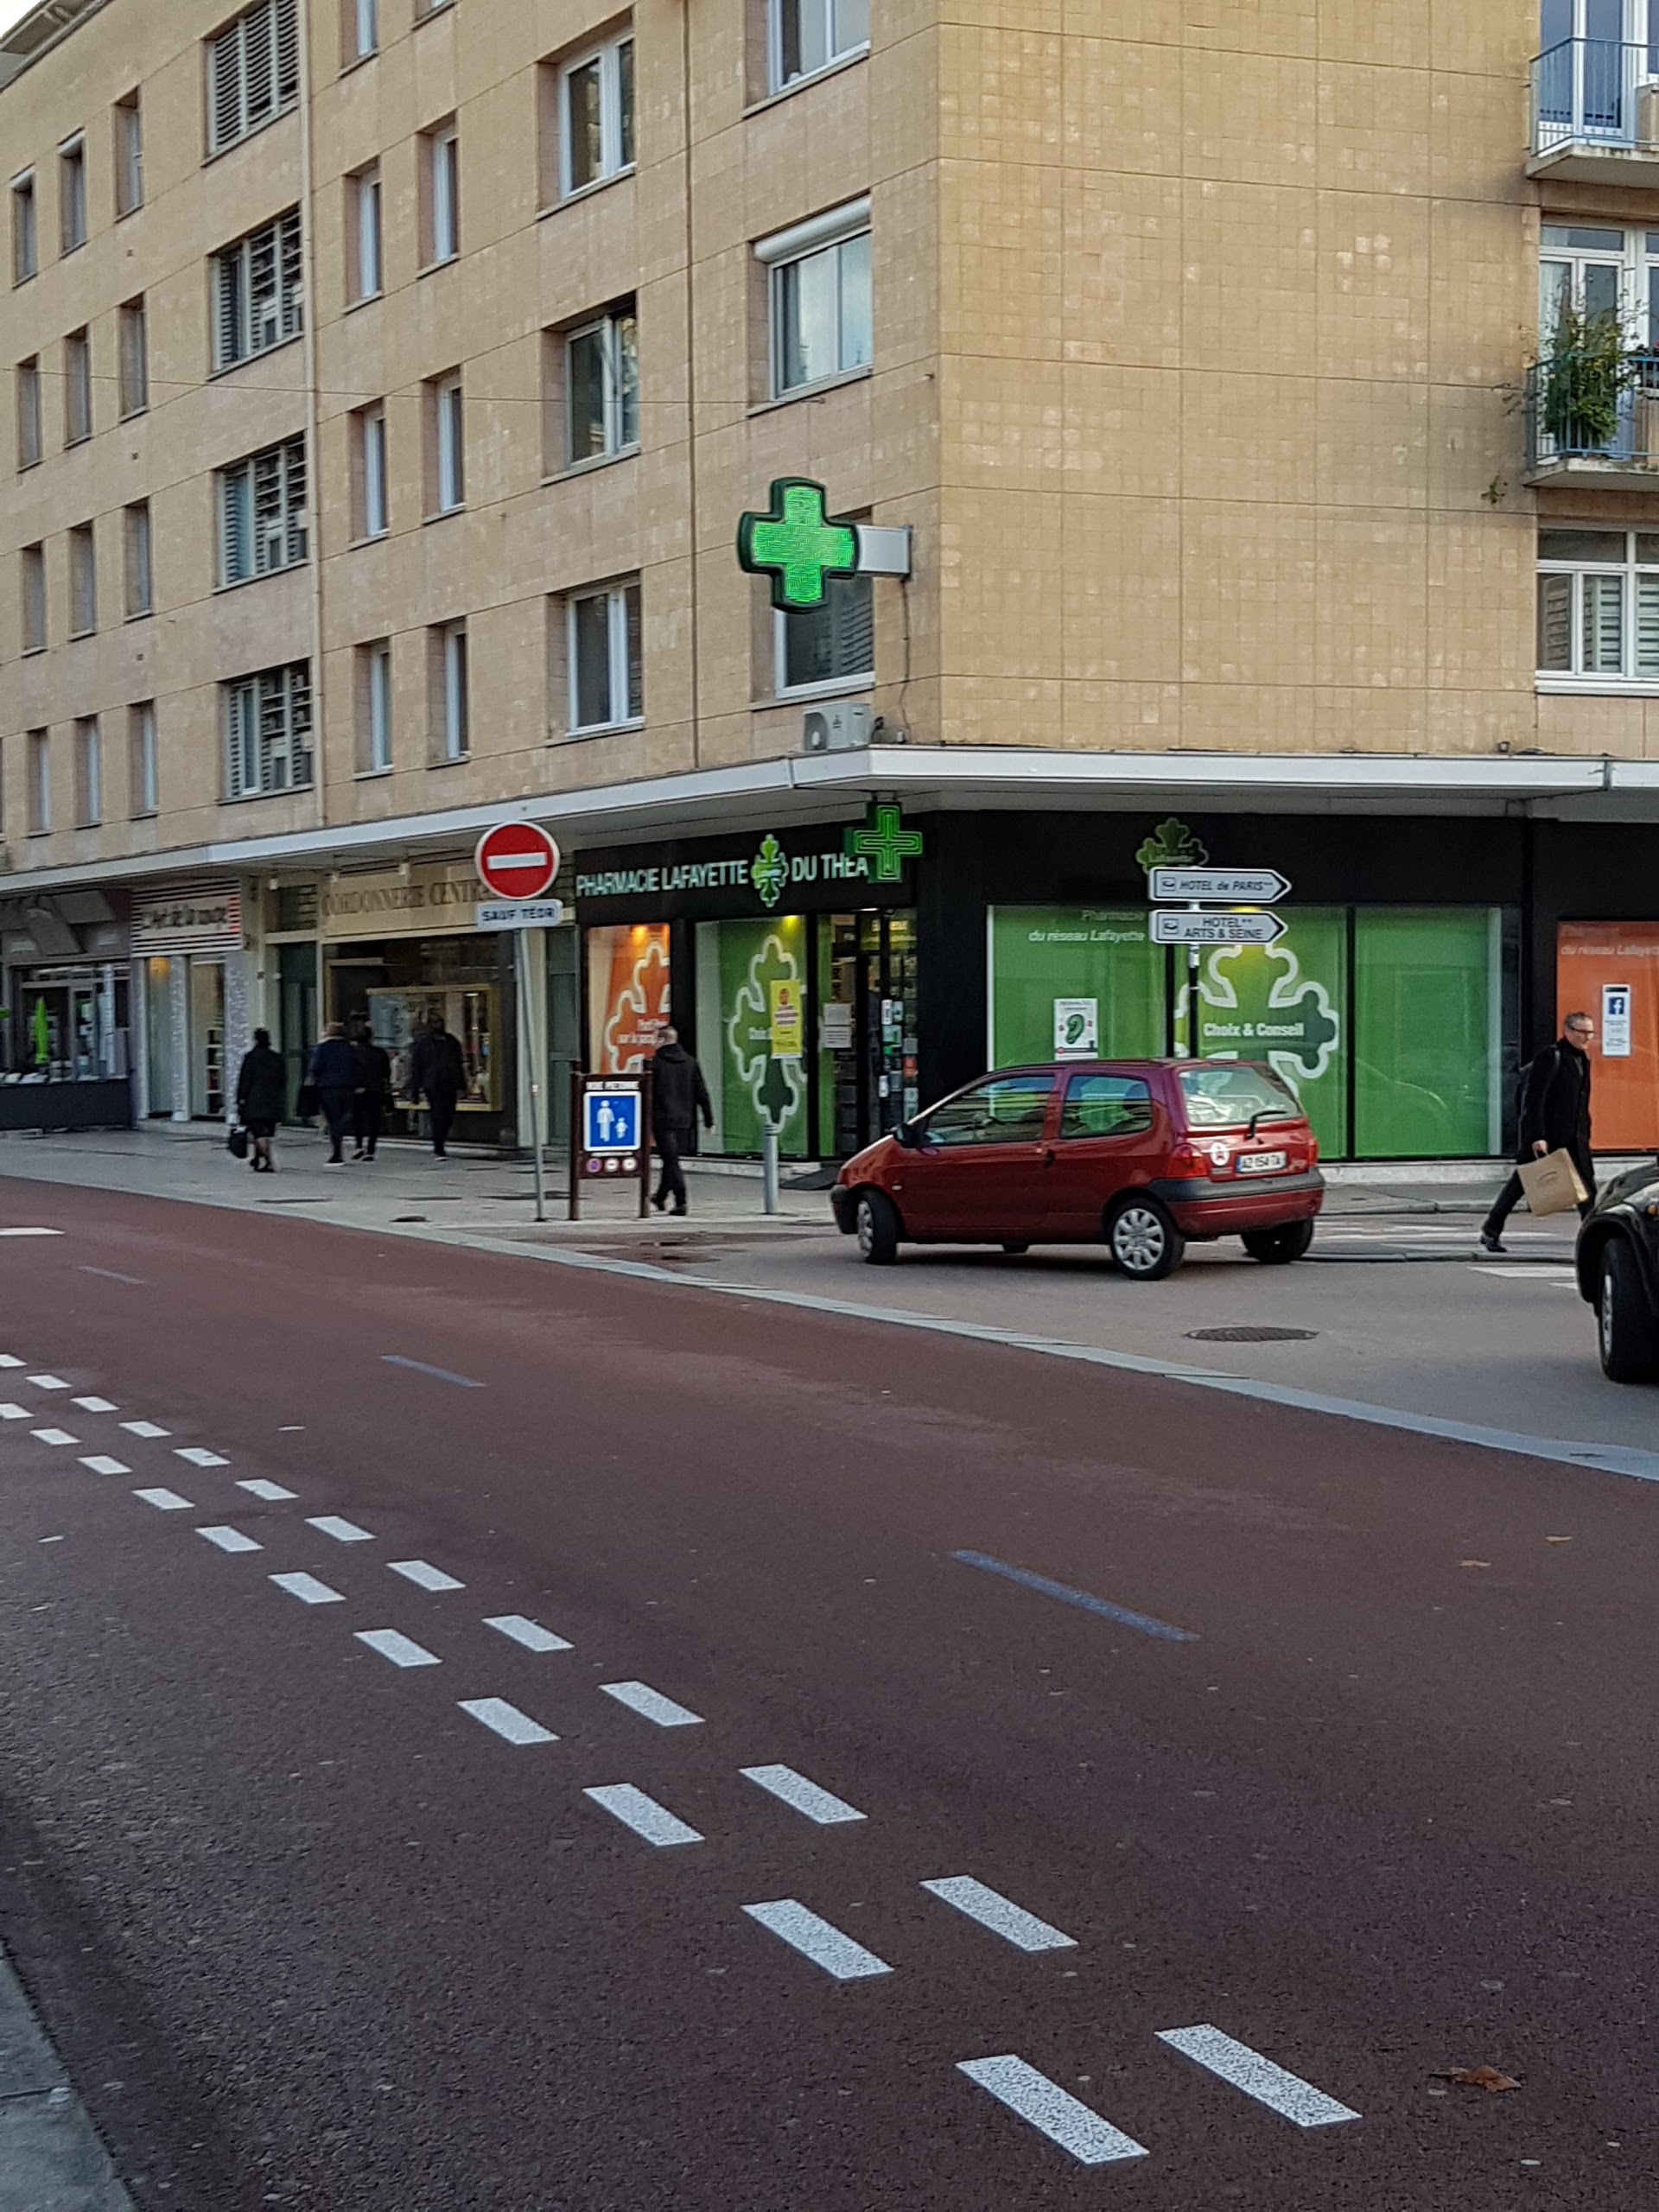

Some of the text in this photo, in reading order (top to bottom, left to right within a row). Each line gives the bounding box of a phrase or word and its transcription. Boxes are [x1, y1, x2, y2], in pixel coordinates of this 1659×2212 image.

[791, 855, 817, 882] DU
[576, 860, 749, 897] PHARMACIE LAFAYETTE
[1179, 880, 1213, 891] HOTEL
[1217, 881, 1230, 891] de
[481, 909, 516, 921] SAUF
[1028, 931, 1045, 942] du
[1090, 930, 1145, 944] Lafayette
[1184, 928, 1263, 939] ARTS & SEINE
[1204, 1023, 1305, 1037] Choix & Conseil
